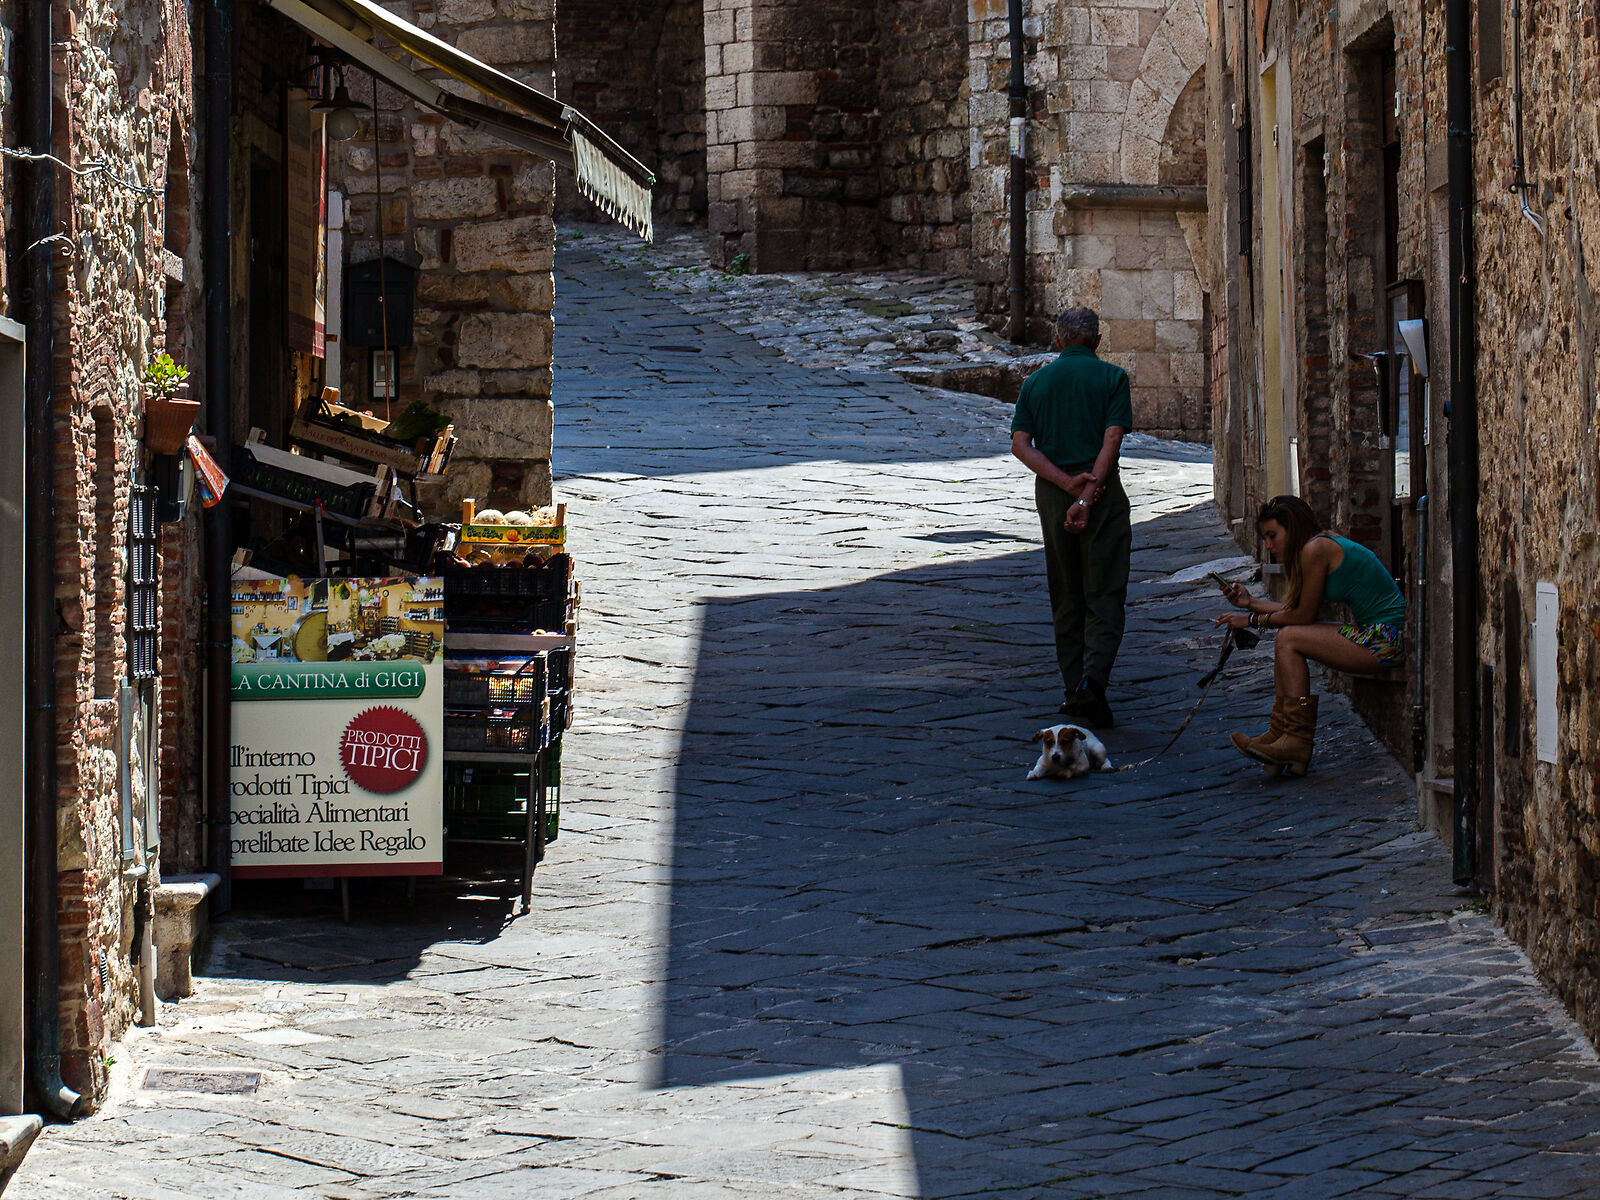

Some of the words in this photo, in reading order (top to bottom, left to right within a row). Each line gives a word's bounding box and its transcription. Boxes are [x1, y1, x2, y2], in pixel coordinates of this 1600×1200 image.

[257, 672, 350, 690] CANTINA
[354, 672, 370, 688] di
[375, 671, 420, 688] GIGI
[346, 729, 421, 749] PRODOTTI
[231, 745, 316, 767] ll'interno
[345, 742, 421, 772] TIPICI
[231, 773, 292, 796] rodotti
[296, 773, 350, 800] Tipici
[231, 802, 301, 824] pecialità
[306, 801, 410, 824] Alimentari
[231, 830, 310, 859] prelibate
[313, 830, 355, 853] Idee
[360, 828, 426, 857] Regalo
